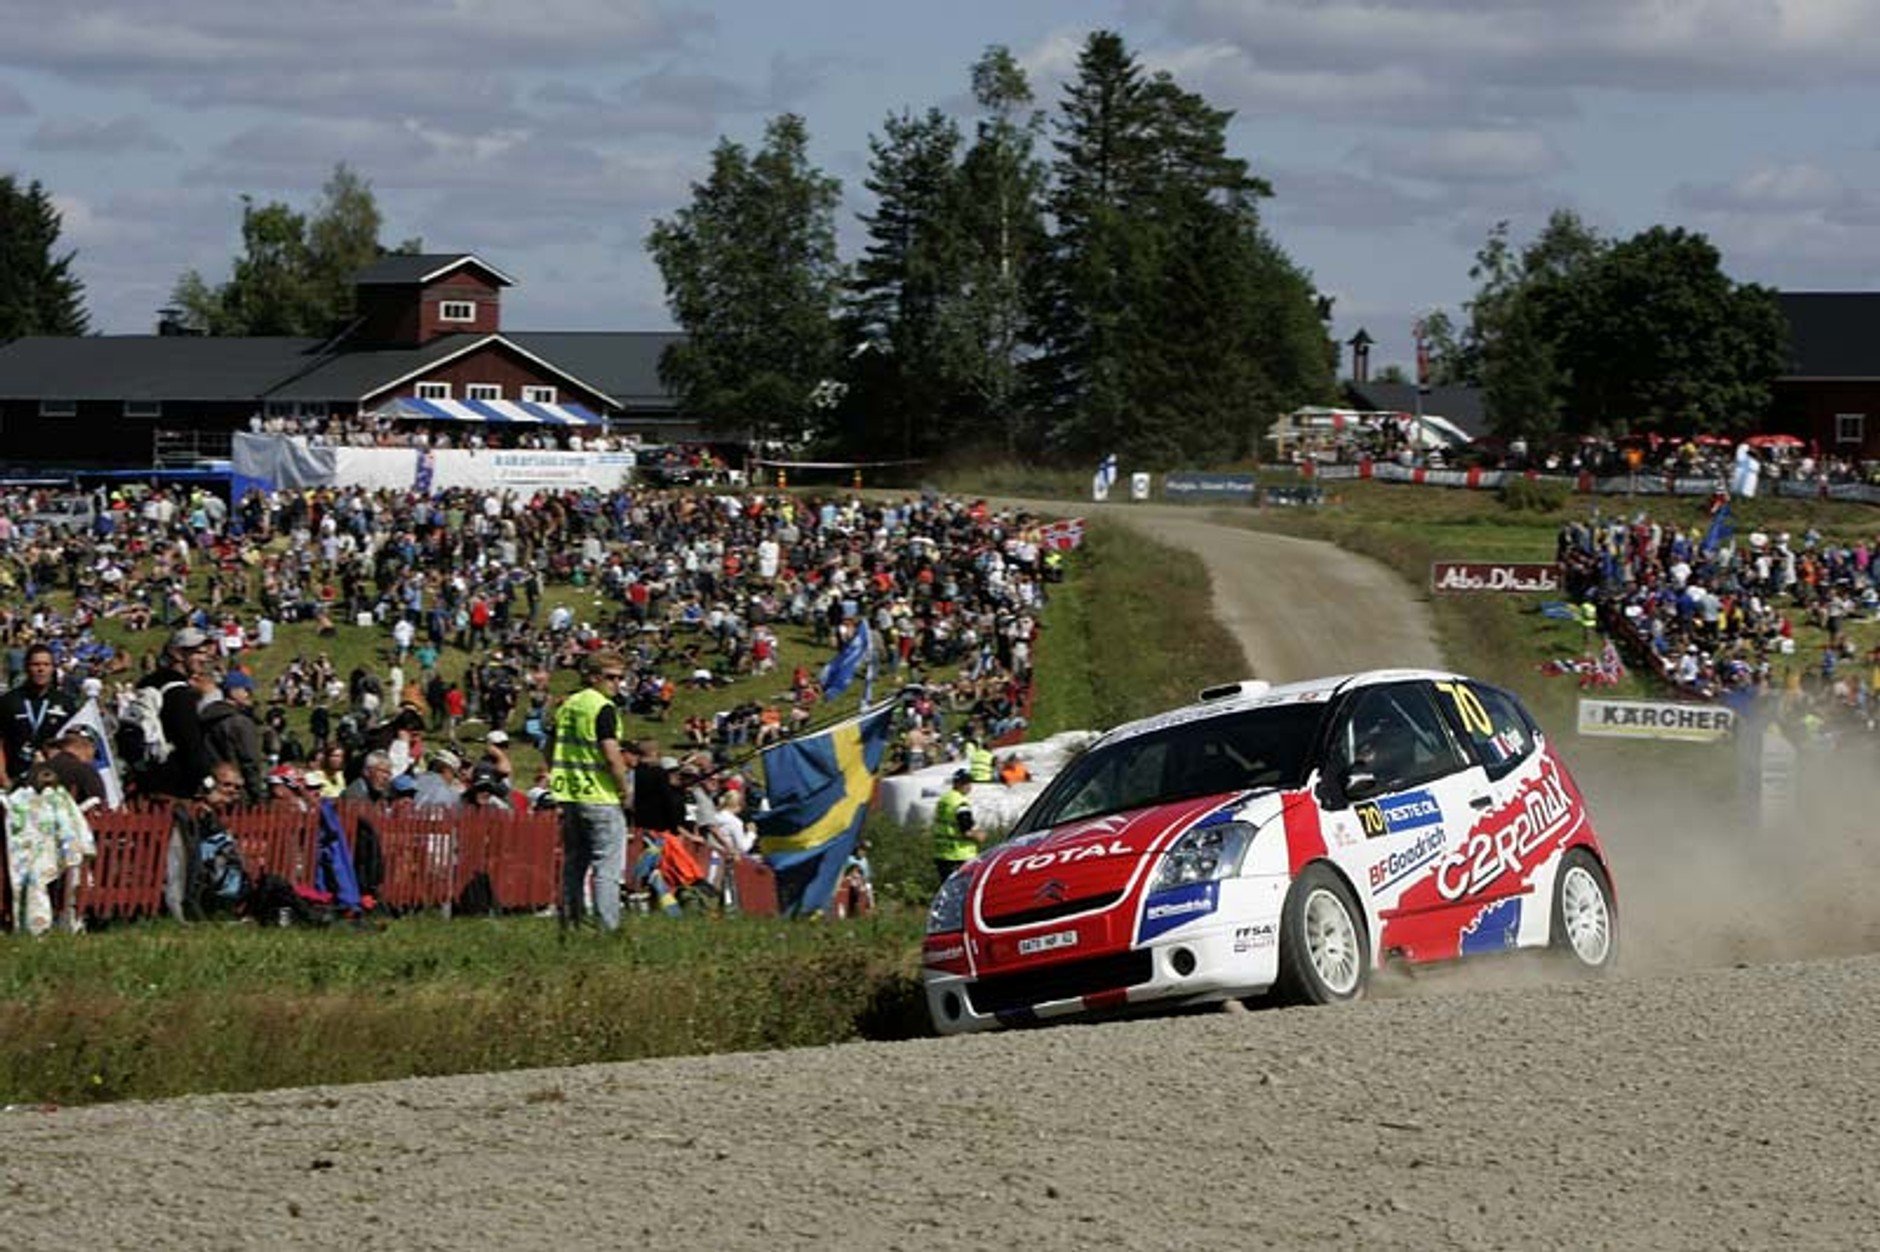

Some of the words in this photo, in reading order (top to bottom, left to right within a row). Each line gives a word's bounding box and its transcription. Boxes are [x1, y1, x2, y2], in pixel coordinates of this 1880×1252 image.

[1435, 683, 1494, 736] 70
[1358, 805, 1384, 833] 70
[1007, 841, 1133, 875] TOTAL
[1369, 827, 1447, 887] BFGoodrich
[1235, 924, 1273, 939] FFSA
